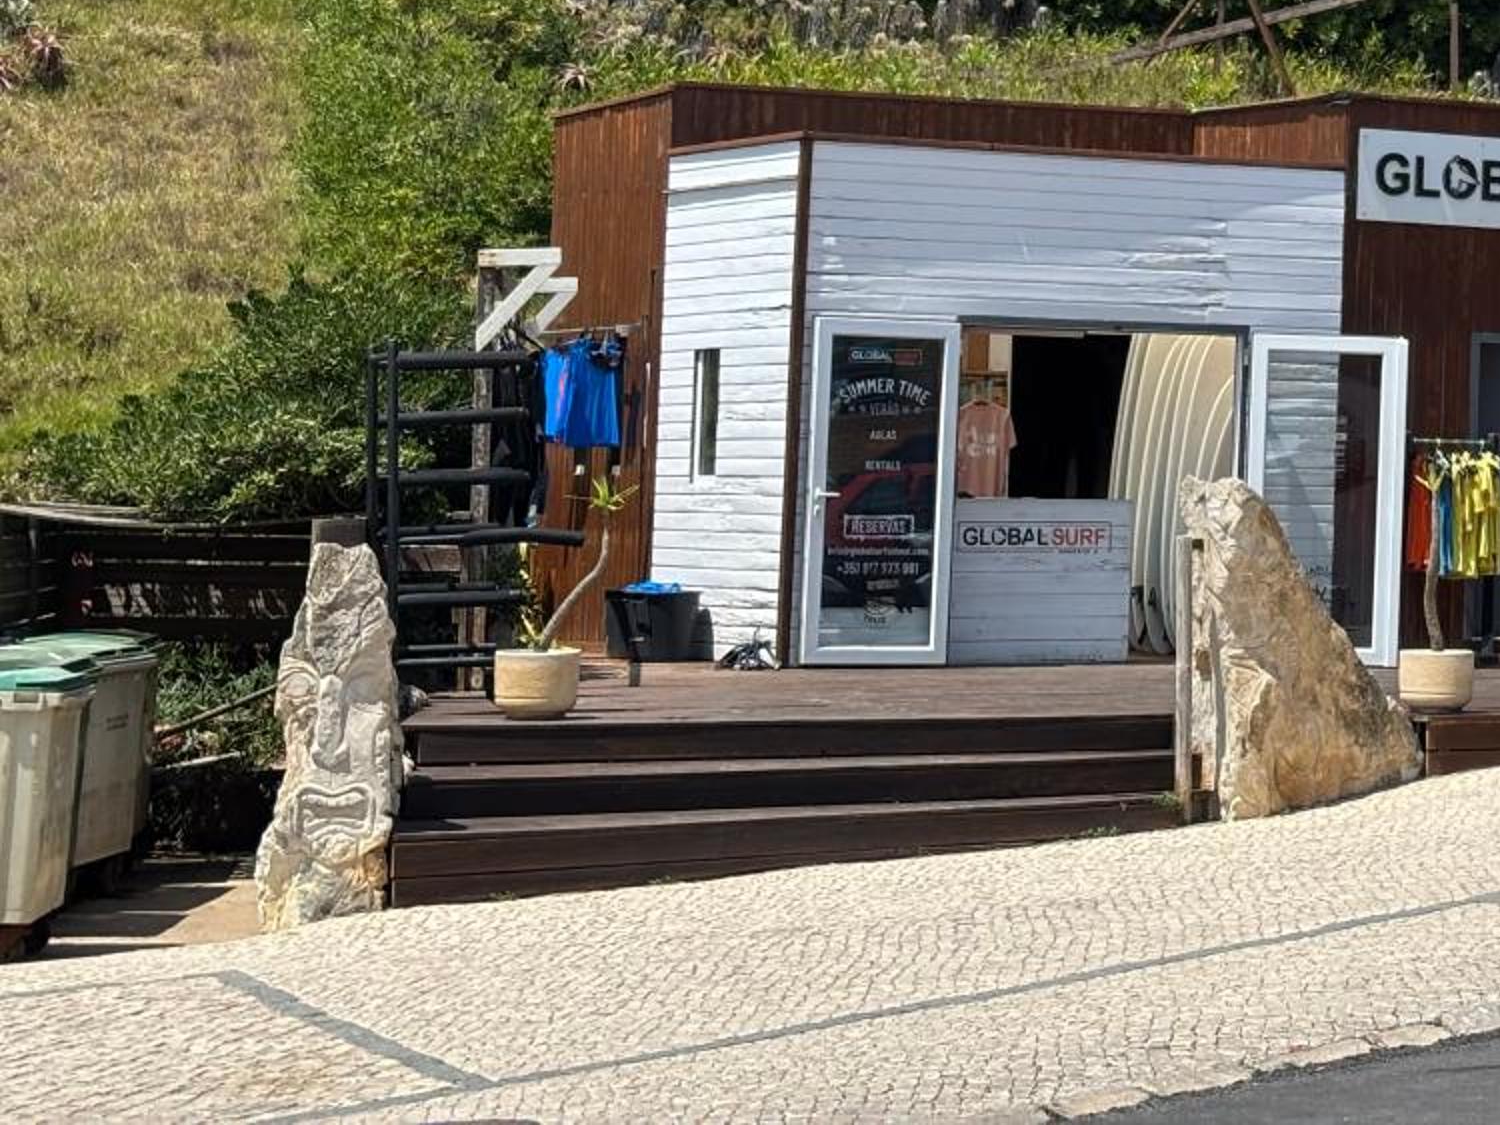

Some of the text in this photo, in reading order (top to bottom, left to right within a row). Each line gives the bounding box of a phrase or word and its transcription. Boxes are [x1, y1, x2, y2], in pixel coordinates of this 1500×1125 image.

[840, 378, 932, 406] SUMMER TIME
[864, 460, 901, 472] RENTALS
[850, 520, 906, 534] RESERVAS
